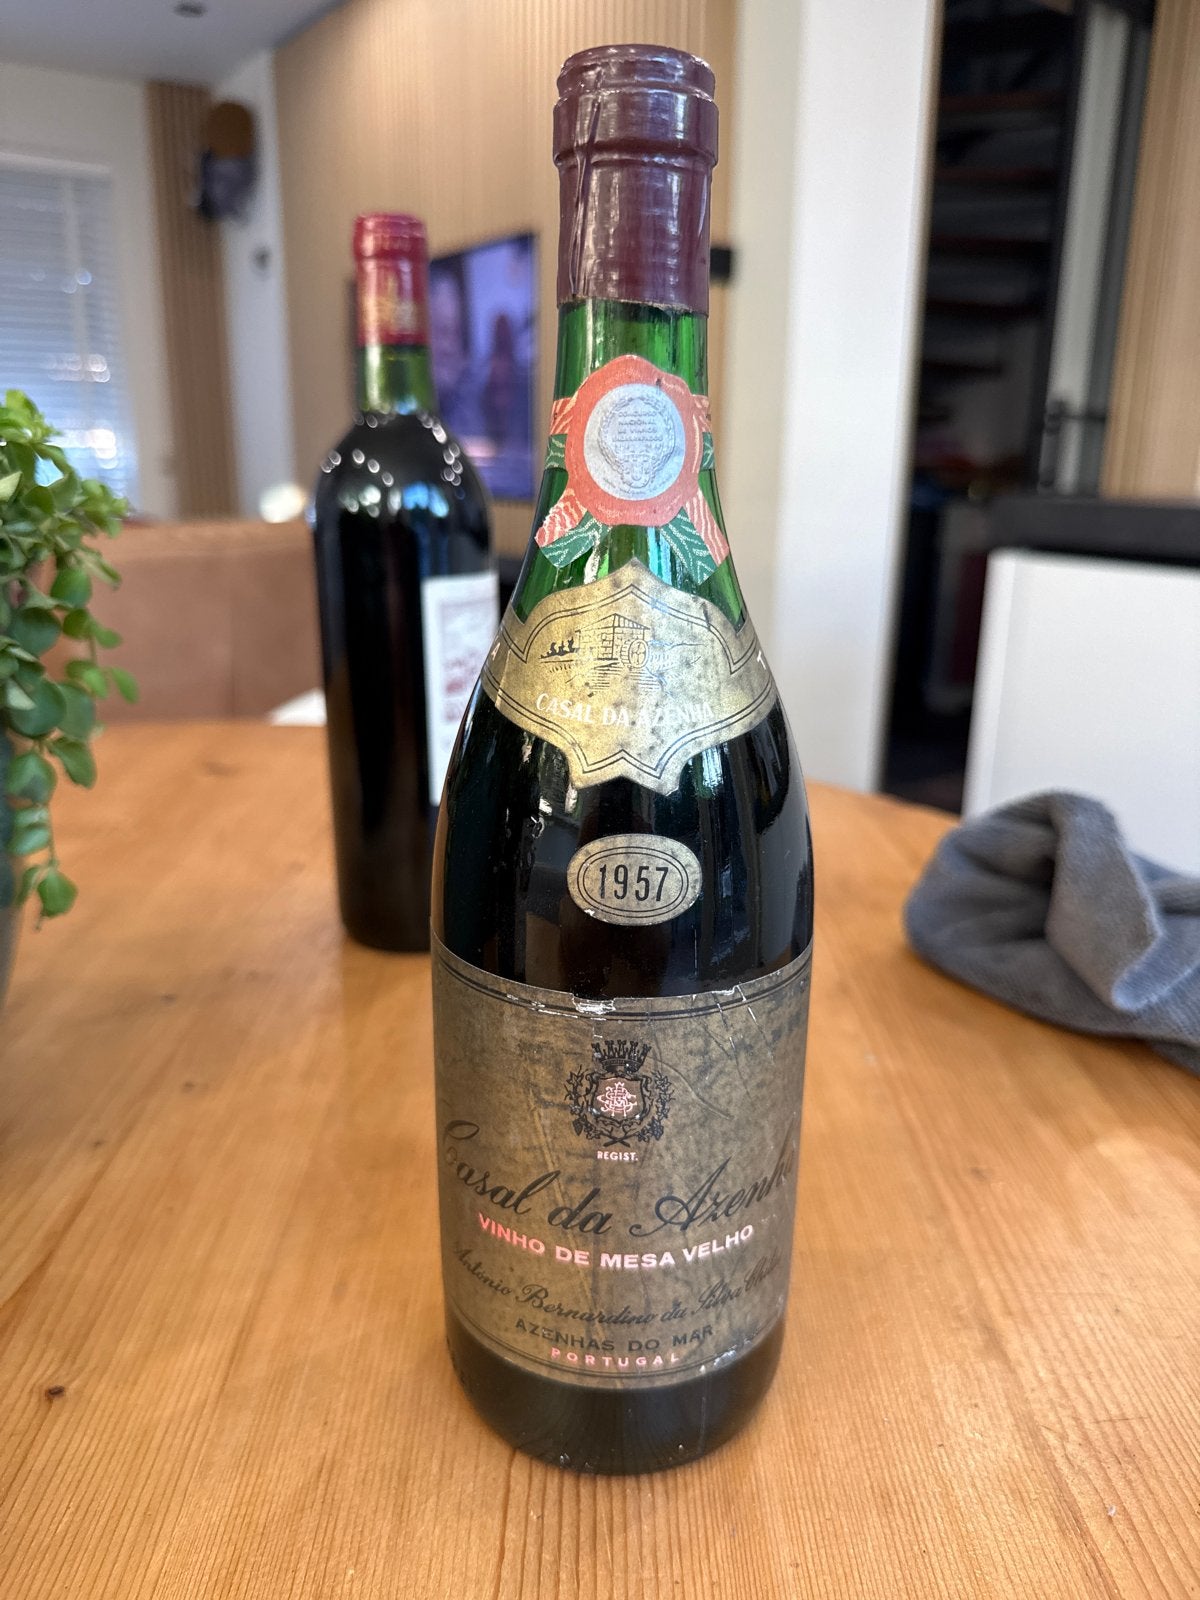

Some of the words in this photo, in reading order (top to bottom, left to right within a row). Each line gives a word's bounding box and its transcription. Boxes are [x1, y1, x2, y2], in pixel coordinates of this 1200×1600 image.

[536, 692, 594, 725] CASAL
[602, 707, 631, 727] DA
[599, 863, 669, 902] 1957
[596, 1150, 639, 1161] REGIST.
[443, 1119, 562, 1215] Casal
[547, 1187, 613, 1235] da
[478, 1211, 546, 1256] VINHO
[555, 1245, 590, 1265] DE
[600, 1251, 676, 1269] MESA
[682, 1224, 754, 1263] VELHO
[514, 1284, 657, 1325] Bernardino
[660, 1300, 688, 1321] da
[515, 1318, 616, 1351] AZENHAS
[628, 1338, 661, 1352] DO
[672, 1324, 714, 1347] MAR
[551, 1347, 680, 1367] PORTUGAL
